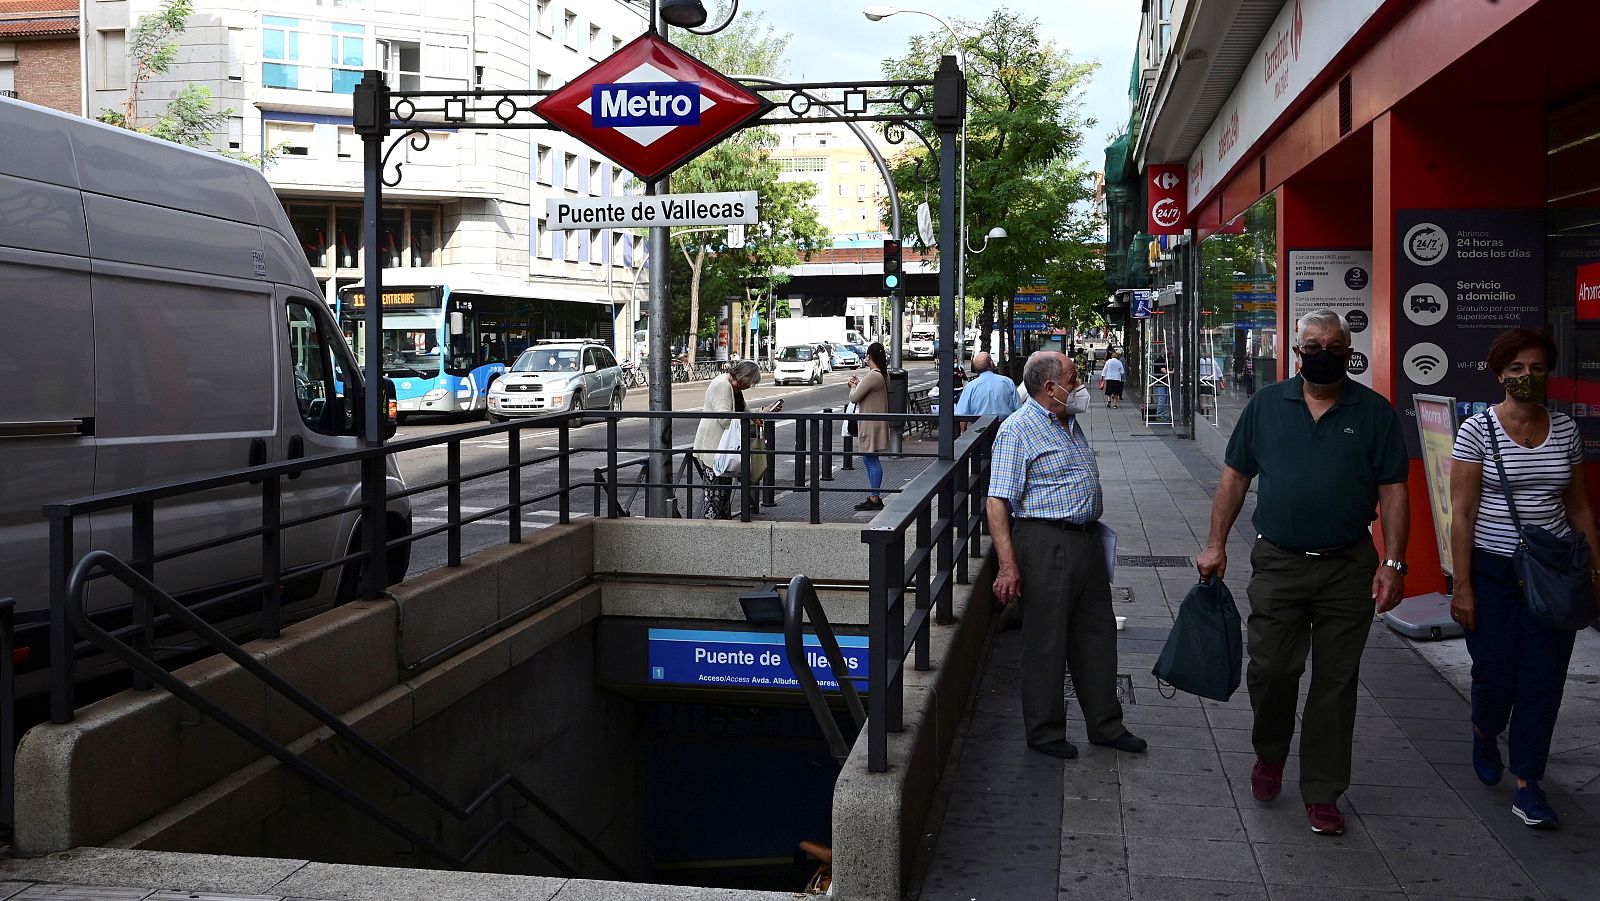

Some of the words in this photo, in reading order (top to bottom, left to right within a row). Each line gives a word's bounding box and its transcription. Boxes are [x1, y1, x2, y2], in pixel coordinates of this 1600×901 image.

[600, 89, 692, 118] Metro
[558, 203, 625, 224] Puente
[631, 201, 656, 221] de
[661, 199, 745, 220] Vallecas
[1157, 208, 1179, 218] 24/7
[1416, 238, 1438, 249] 24/7
[1456, 238, 1471, 247] 24
[1472, 238, 1504, 247] horas
[1456, 249, 1489, 258] todos
[1490, 249, 1506, 258] los
[1507, 249, 1531, 258] días
[1352, 268, 1361, 278] 3
[1456, 280, 1501, 289] Servicio
[382, 293, 415, 305] ENTREVIAS
[1465, 292, 1516, 301] domicilio
[1490, 306, 1503, 314] por
[1456, 313, 1497, 322] superiores
[695, 648, 754, 666] Puente
[759, 650, 781, 666] de
[655, 668, 662, 677] 1
[698, 674, 750, 683] Acceso/Access
[772, 677, 800, 685] Albufer
